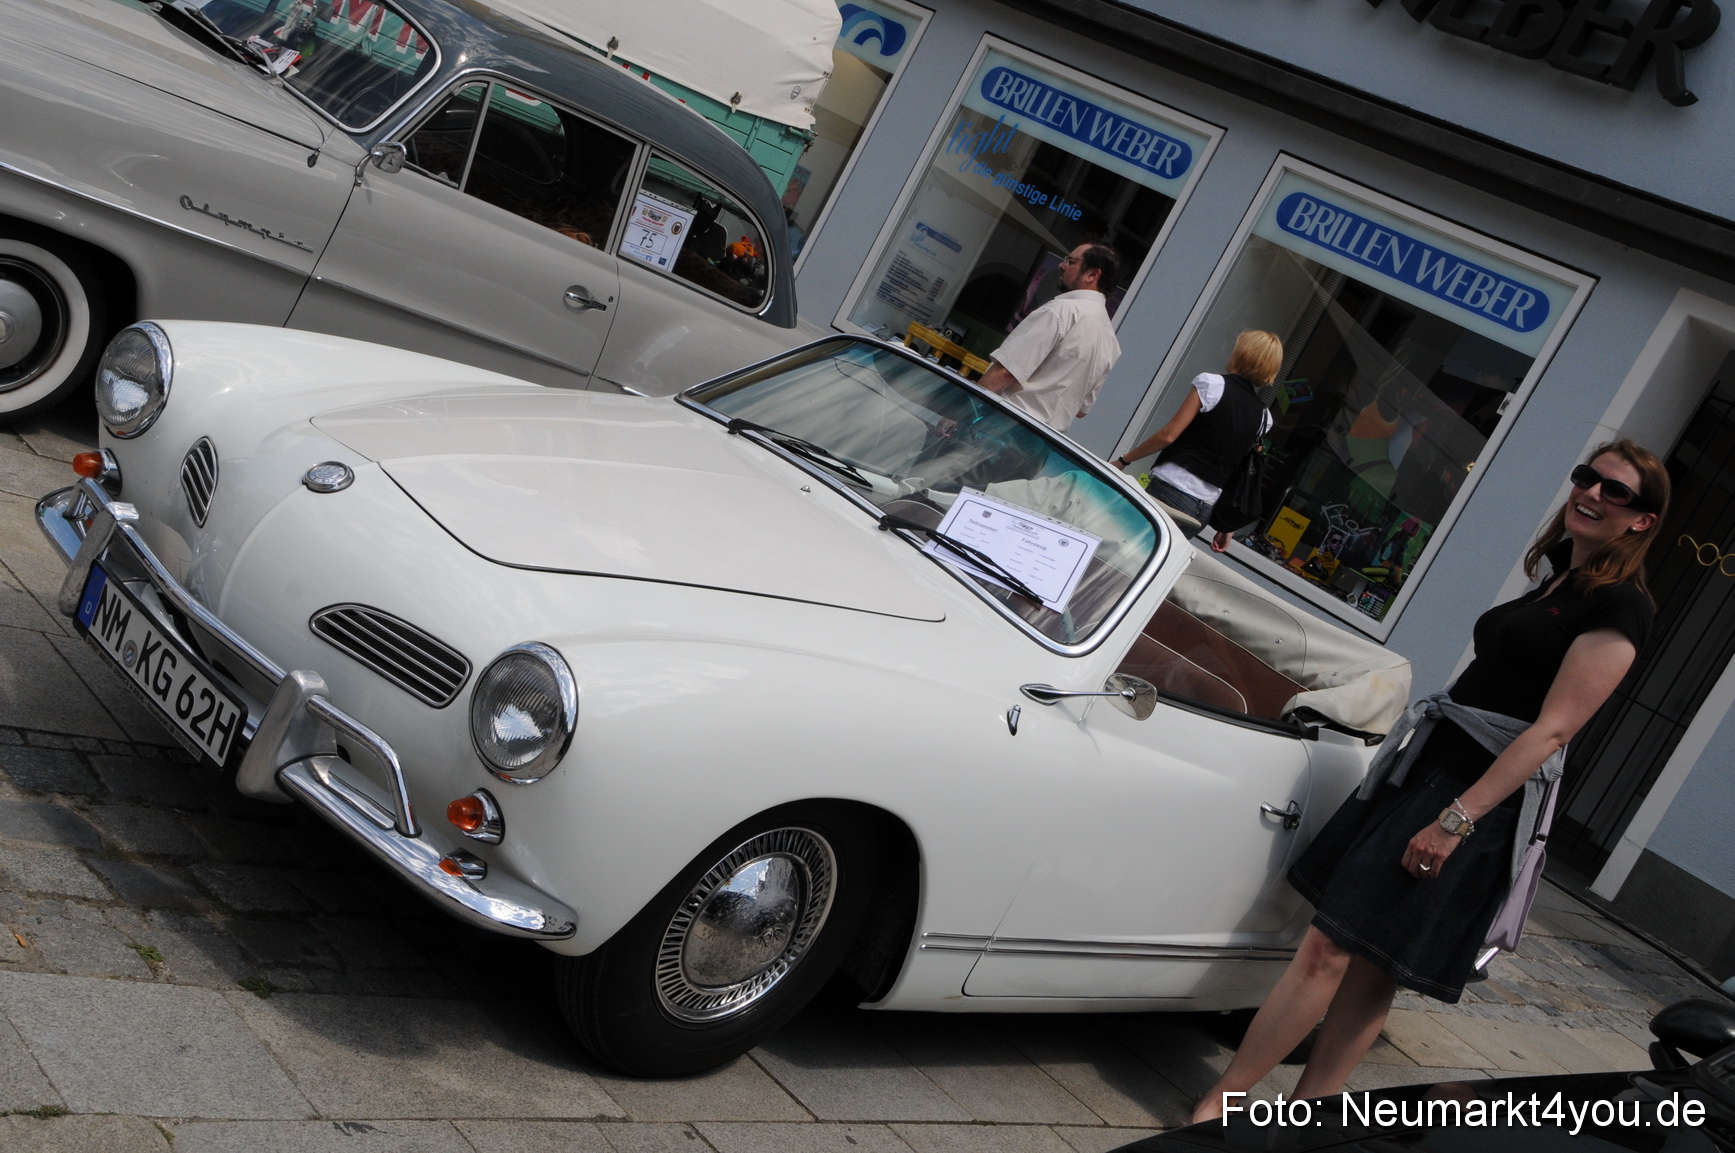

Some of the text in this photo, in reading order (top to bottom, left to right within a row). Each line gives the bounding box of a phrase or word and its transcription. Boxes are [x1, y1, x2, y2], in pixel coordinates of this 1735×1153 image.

[946, 114, 1019, 172] light
[989, 71, 1182, 176] BRILLEN WEBER
[973, 160, 1082, 221] die günstige Linie
[640, 229, 657, 248] 75
[1287, 197, 1536, 329] BRILLEN WEBER
[1021, 537, 1047, 551] Fahrzeug
[85, 601, 92, 614] D
[92, 584, 237, 758] NM KG 62H
